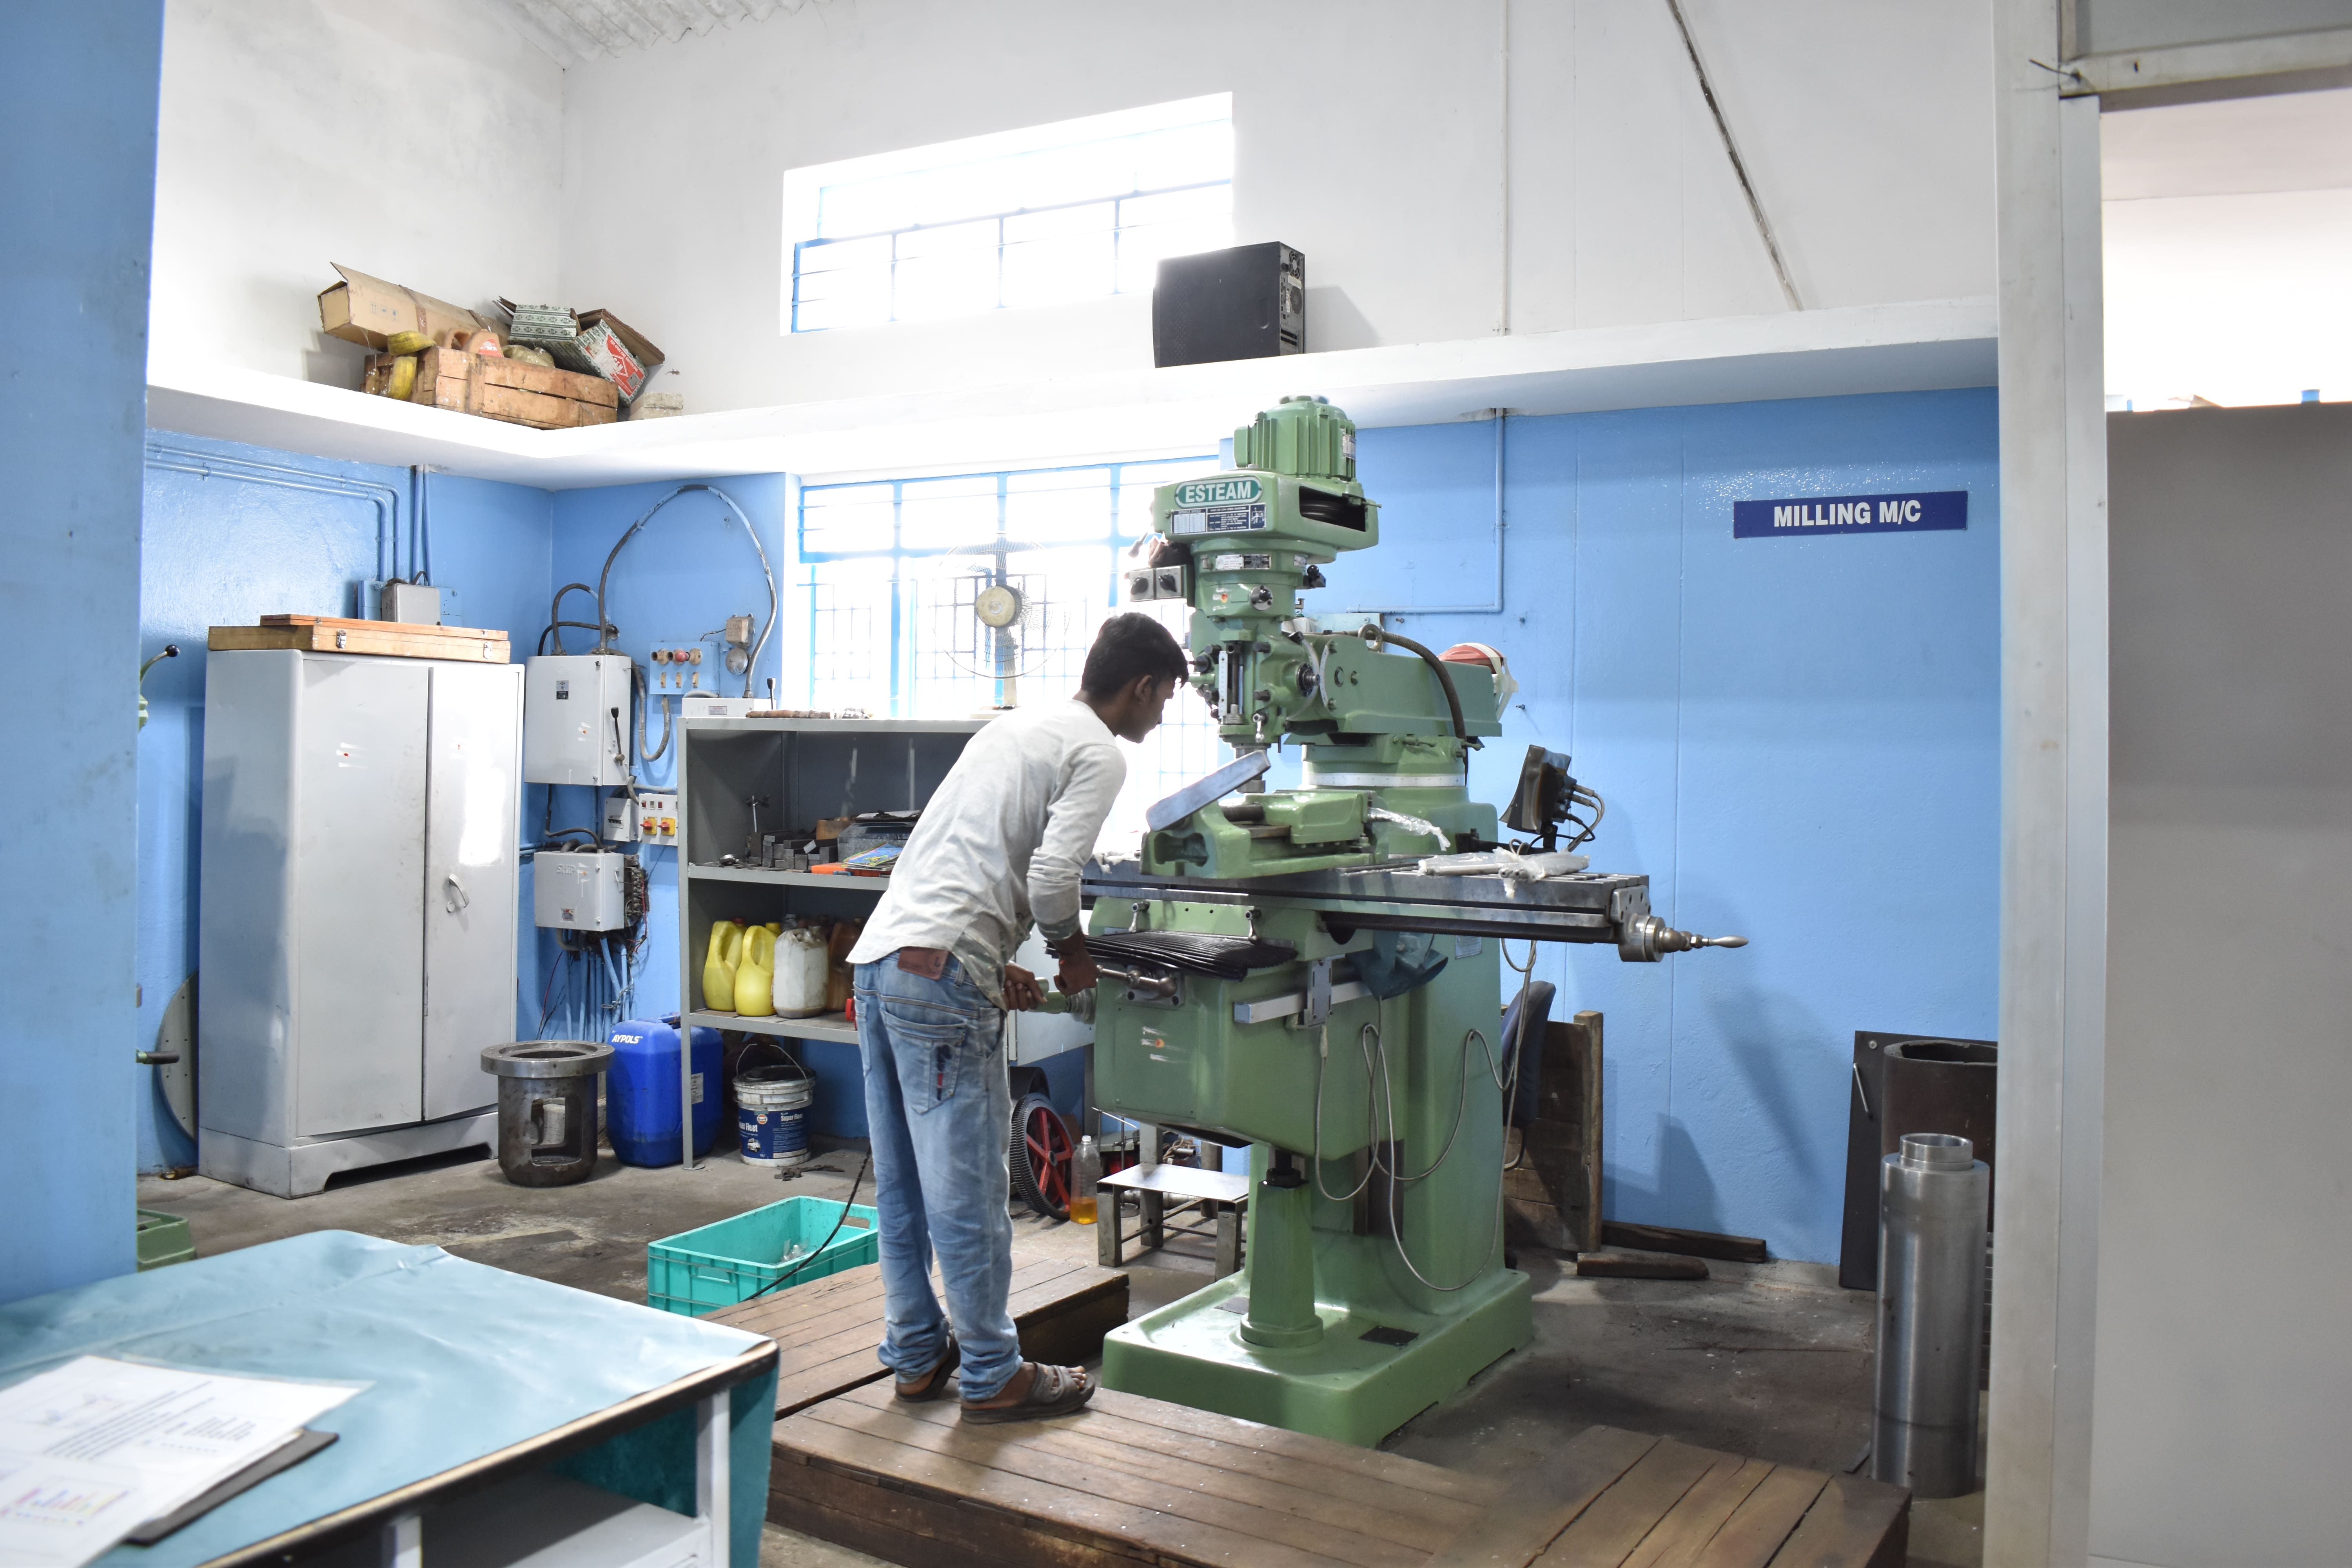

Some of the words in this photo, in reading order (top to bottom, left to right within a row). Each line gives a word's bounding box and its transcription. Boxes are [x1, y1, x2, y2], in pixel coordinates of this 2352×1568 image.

[1185, 481, 1251, 503] ESTEAM
[1774, 502, 1871, 527] MILLING
[1879, 500, 1921, 524] M/C
